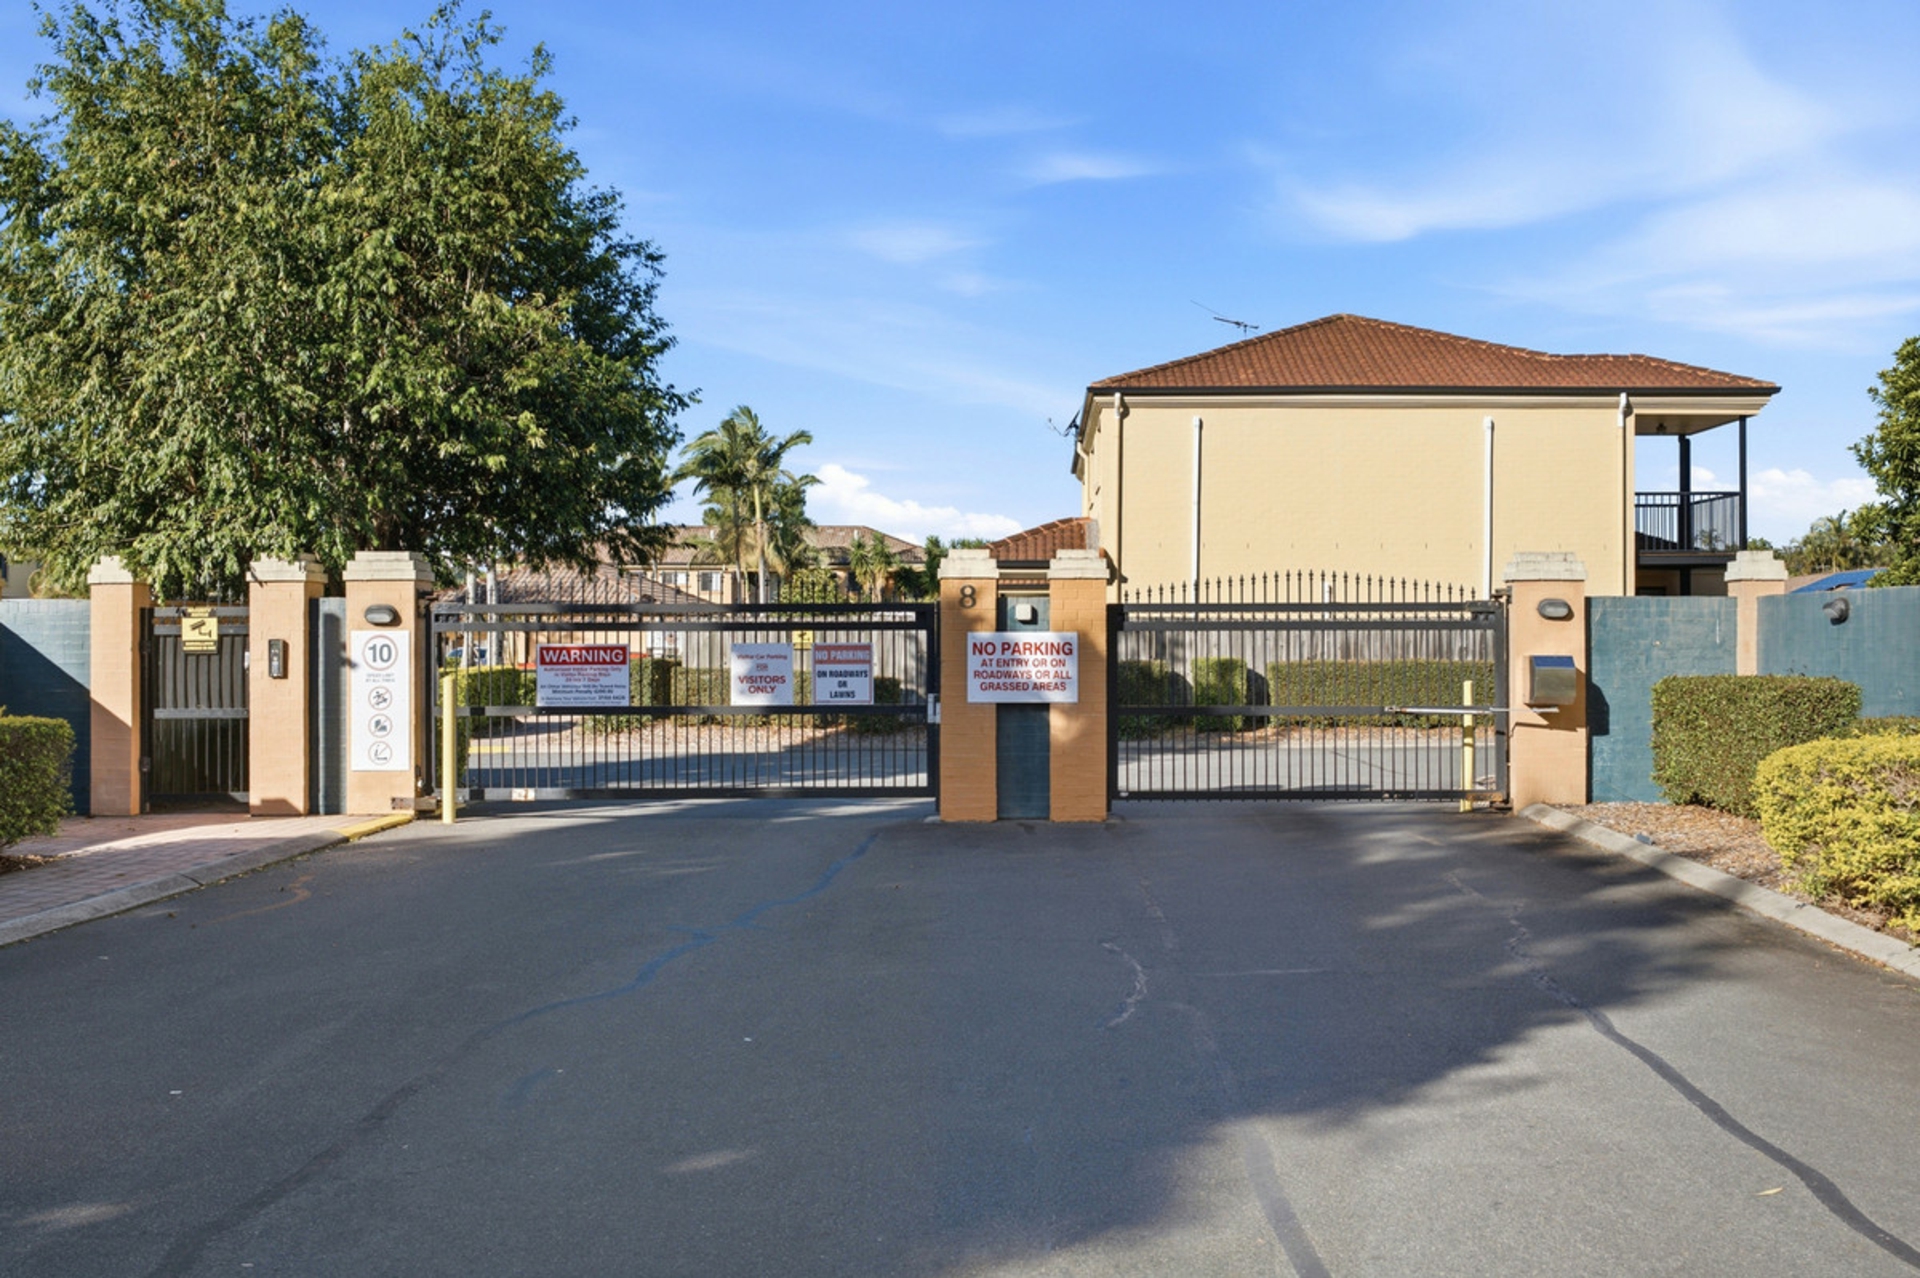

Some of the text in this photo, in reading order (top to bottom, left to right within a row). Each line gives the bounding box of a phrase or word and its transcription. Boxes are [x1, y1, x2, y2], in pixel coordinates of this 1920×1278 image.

[960, 585, 976, 609] 8
[368, 643, 392, 663] 10
[972, 641, 1073, 656] NO PARKING
[542, 649, 624, 663] WARNING
[755, 653, 765, 661] Car
[766, 653, 788, 661] Parking
[815, 650, 870, 660] NO PARKING
[981, 659, 1066, 668] AT ENTRY OR ON
[817, 669, 869, 679] ON ROADWAYS
[973, 669, 1073, 680] ROADWAYS OR ALL
[738, 675, 787, 685] VISITORS
[837, 680, 849, 689] OR
[748, 685, 776, 694] ONLY
[980, 681, 1067, 692] GRASSED AREAS
[830, 690, 856, 699] LAWNS
